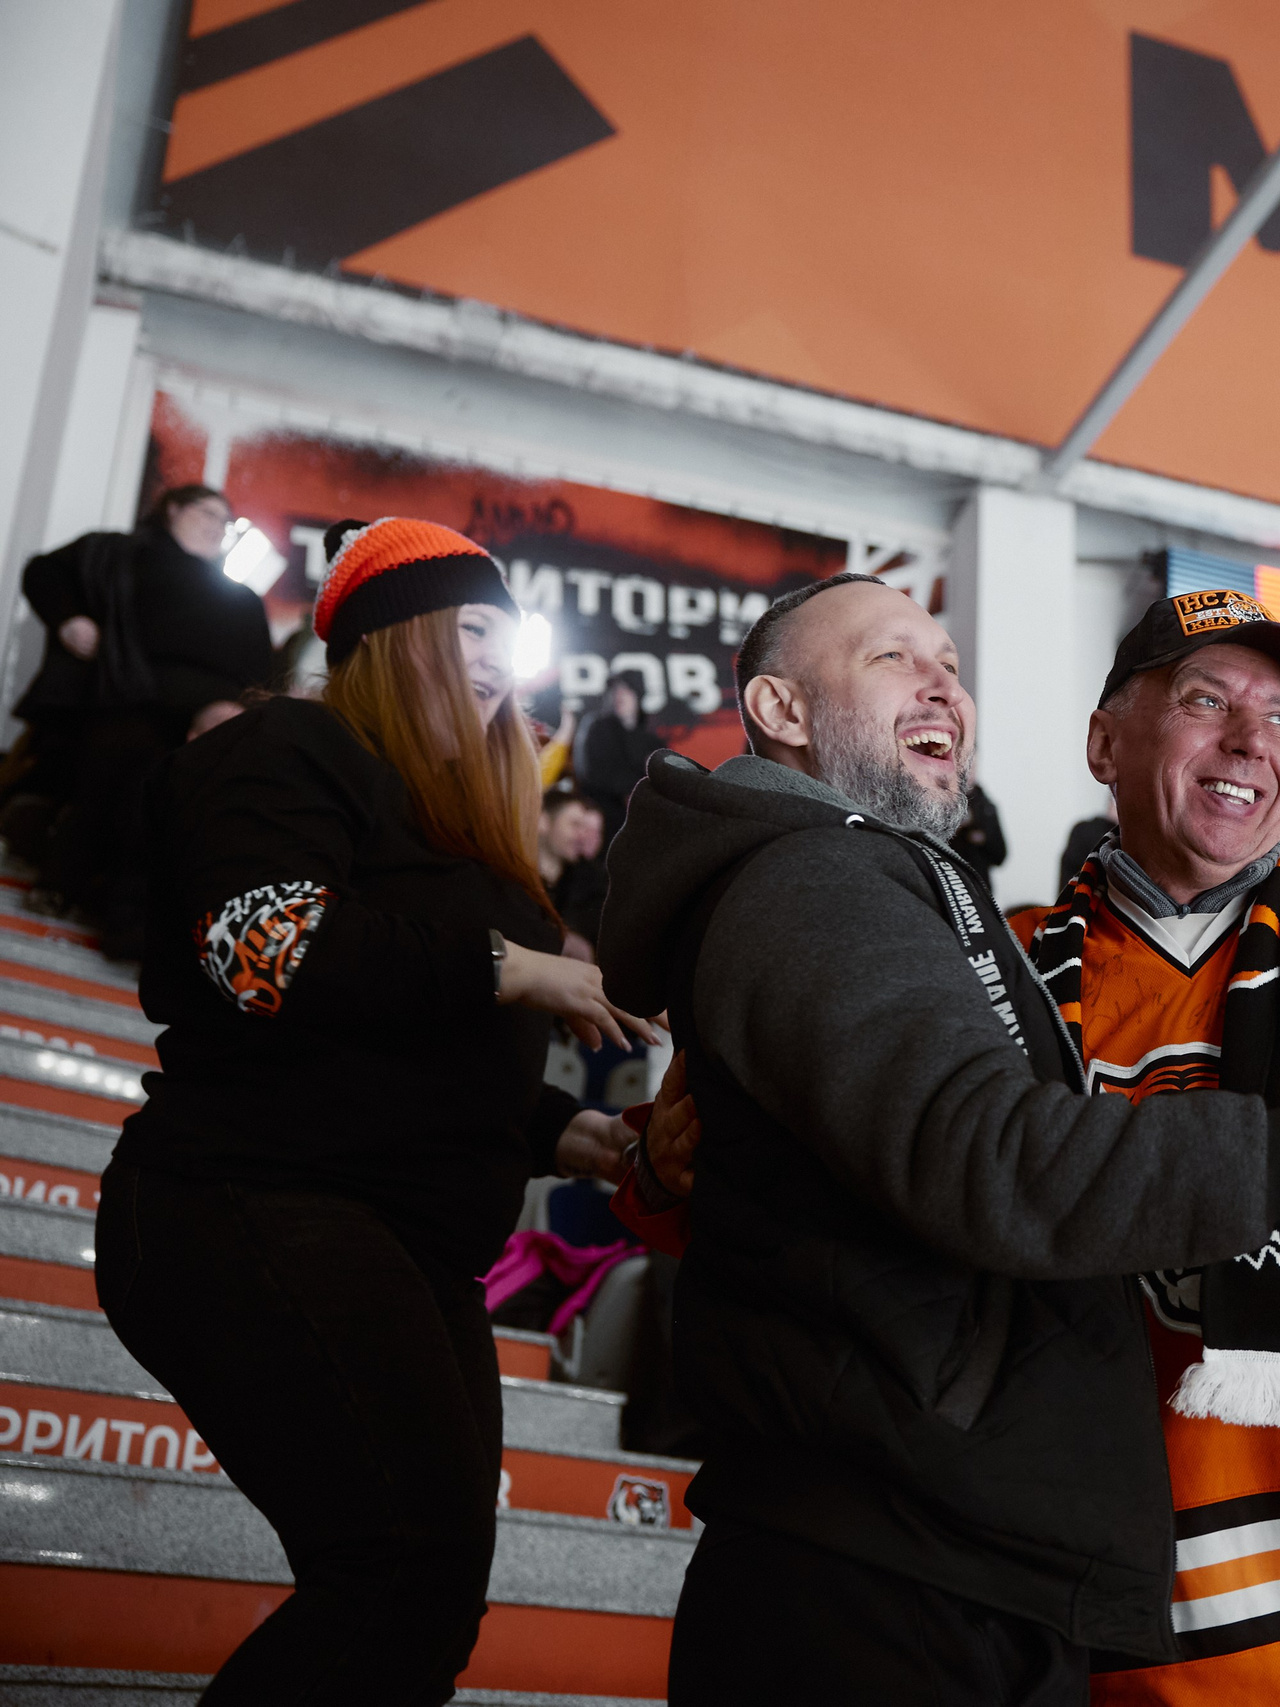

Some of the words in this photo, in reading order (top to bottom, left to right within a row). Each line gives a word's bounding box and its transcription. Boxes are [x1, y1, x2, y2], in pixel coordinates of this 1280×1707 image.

[290, 525, 772, 646] ТИТОРИ
[1180, 592, 1219, 613] HC
[1190, 616, 1246, 630] KHAB
[558, 651, 722, 715] РОВ
